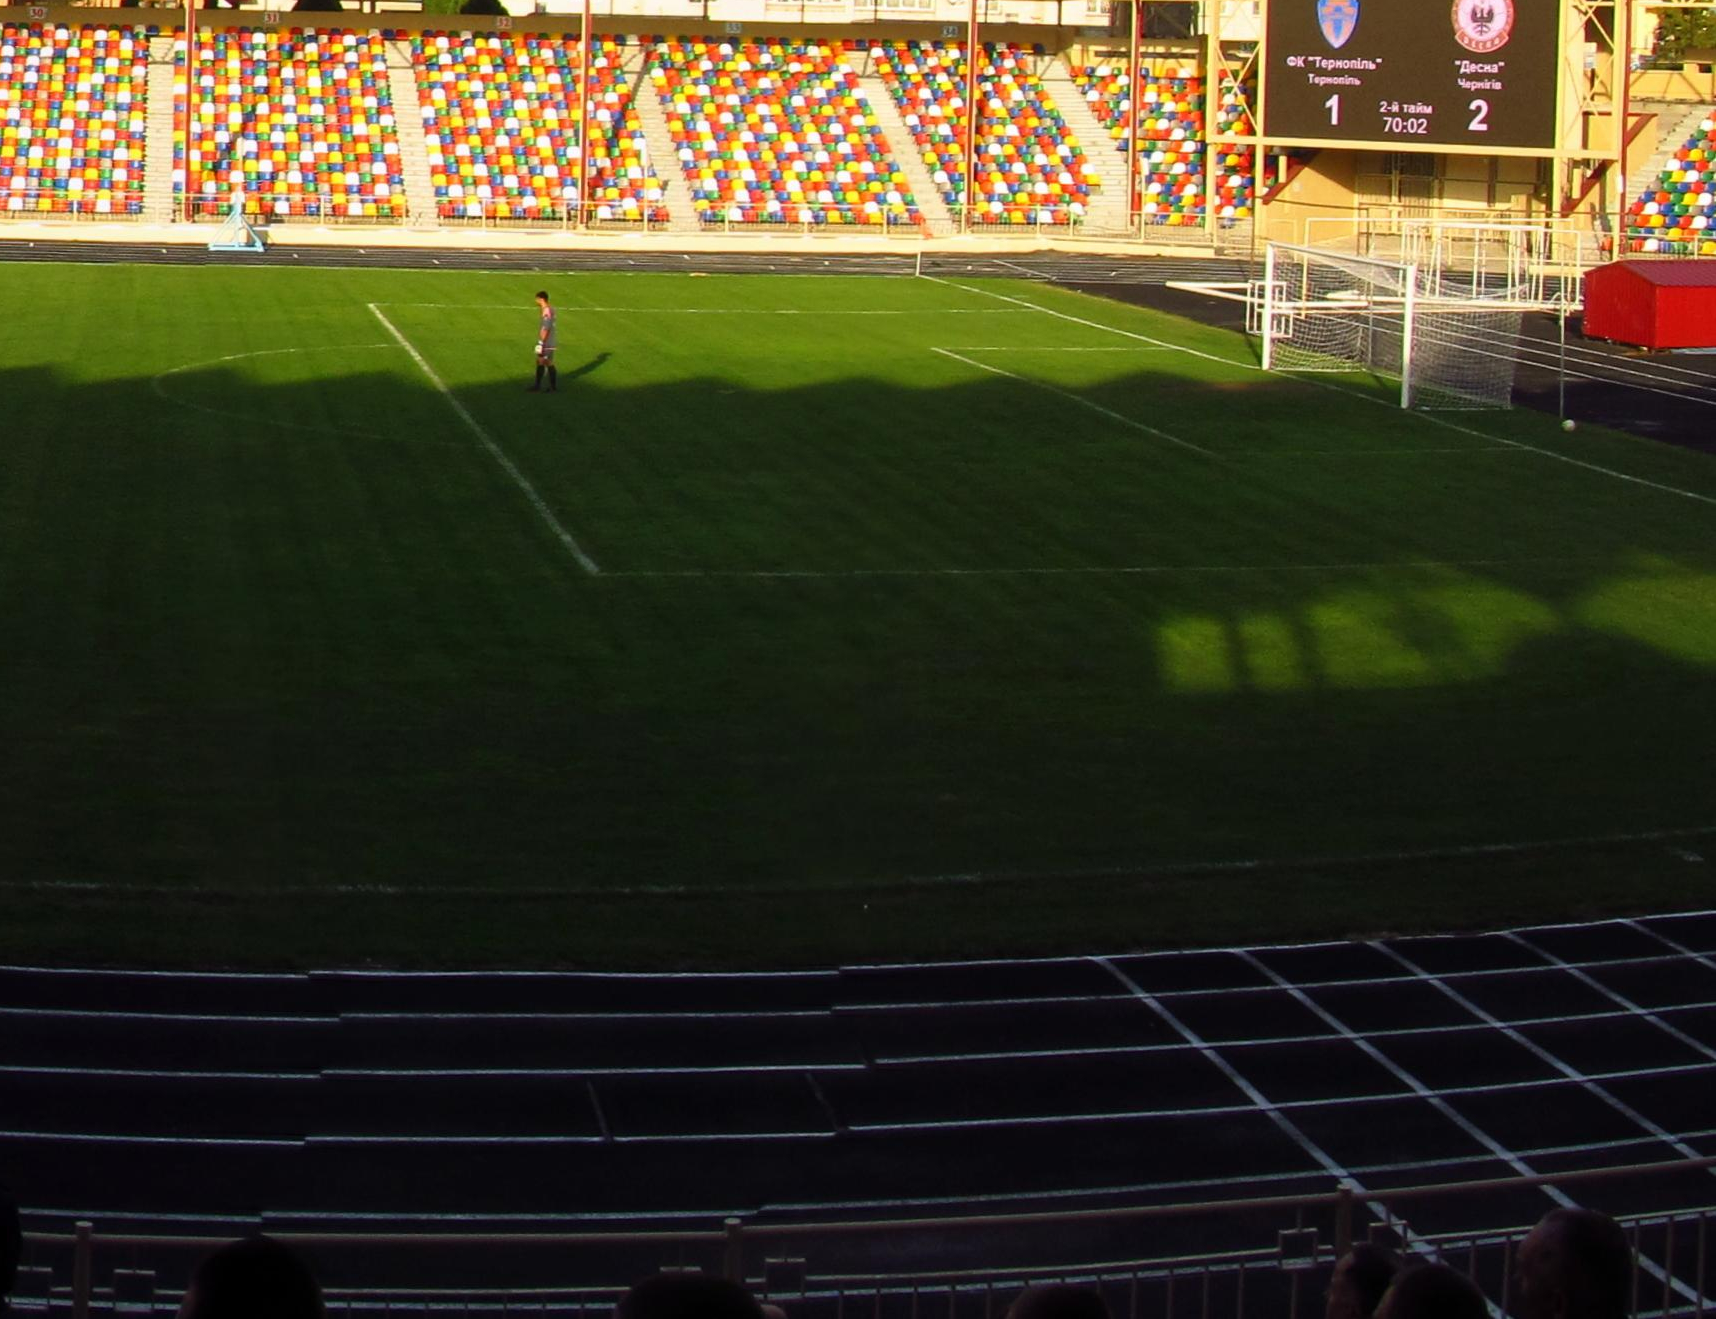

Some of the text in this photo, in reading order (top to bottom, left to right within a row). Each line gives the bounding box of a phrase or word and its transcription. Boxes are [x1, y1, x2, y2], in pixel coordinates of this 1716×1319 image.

[1286, 56, 1383, 71] ФК "Тернопіль"
[1454, 60, 1505, 75] "Десна"
[1308, 73, 1362, 86] Тернопіль
[1457, 78, 1503, 92] Чернігів
[1324, 94, 1340, 126] 1
[1379, 101, 1433, 115] 2-й тайм
[1468, 99, 1489, 131] 2
[1383, 117, 1428, 134] 70:02
